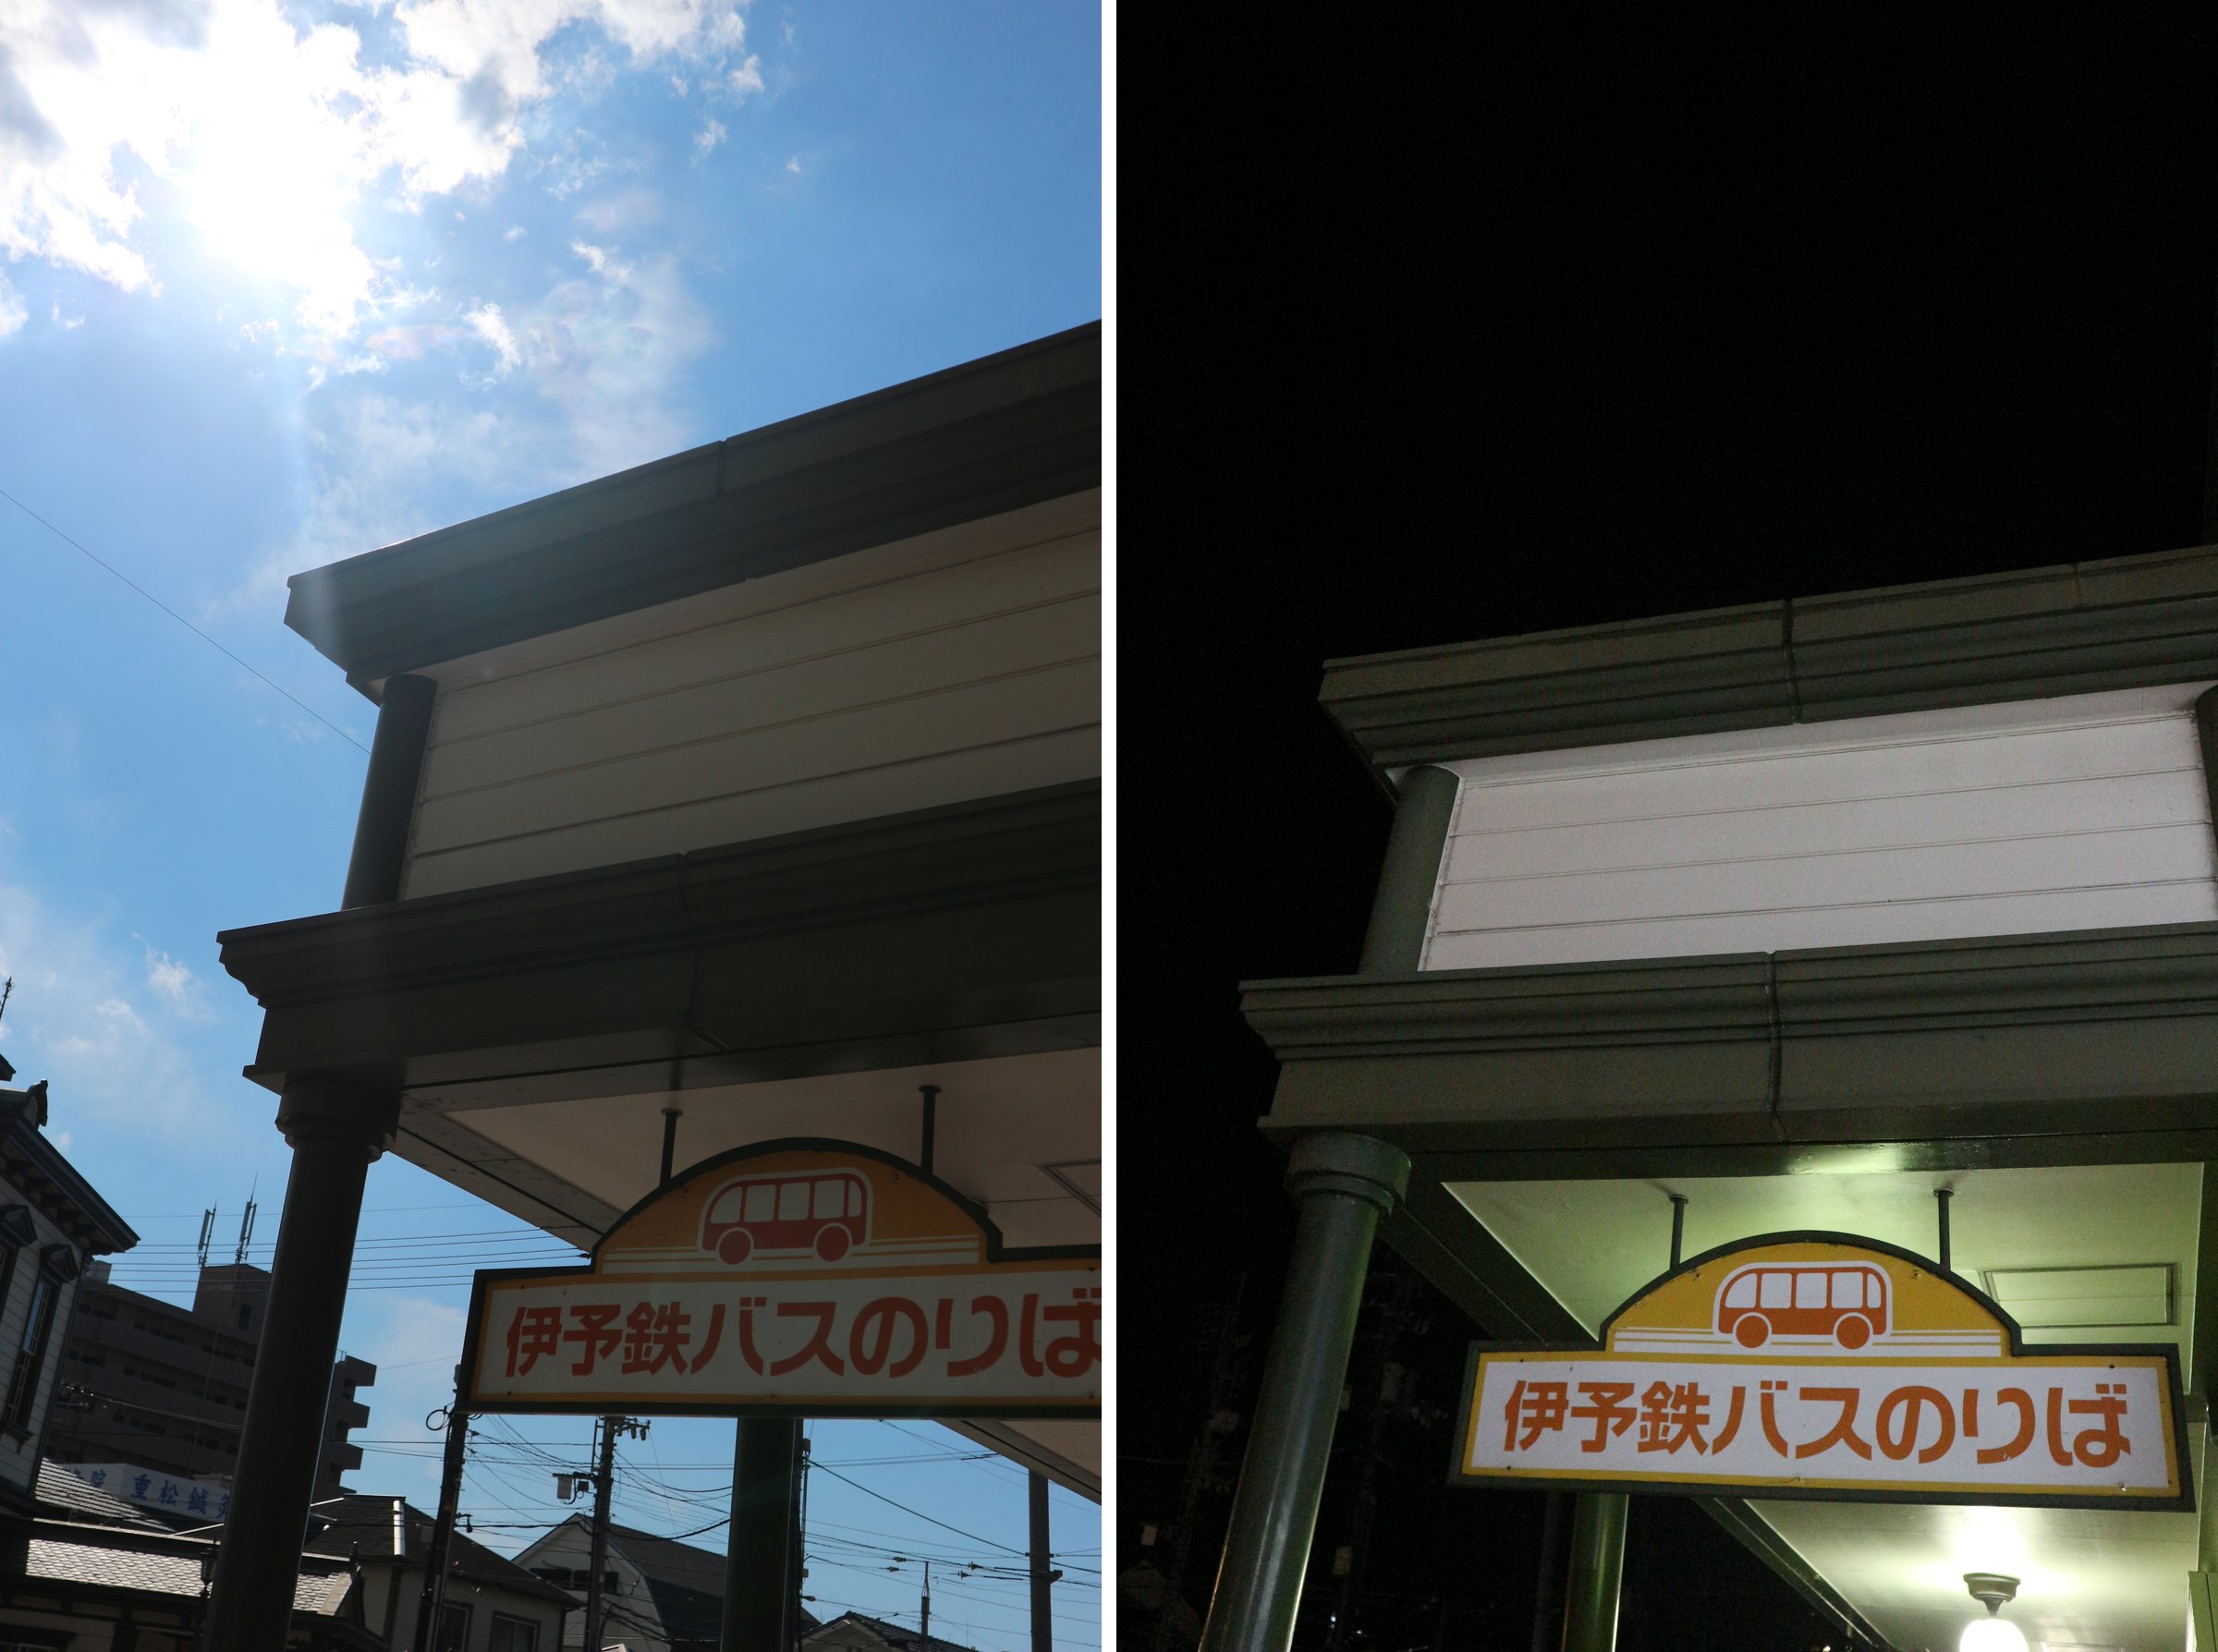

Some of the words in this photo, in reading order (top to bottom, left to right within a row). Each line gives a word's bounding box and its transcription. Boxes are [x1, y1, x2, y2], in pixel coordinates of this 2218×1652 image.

[506, 1288, 1102, 1379] 伊予鉄バスのりば
[1504, 1379, 2132, 1467] 伊予鉄バスのりば
